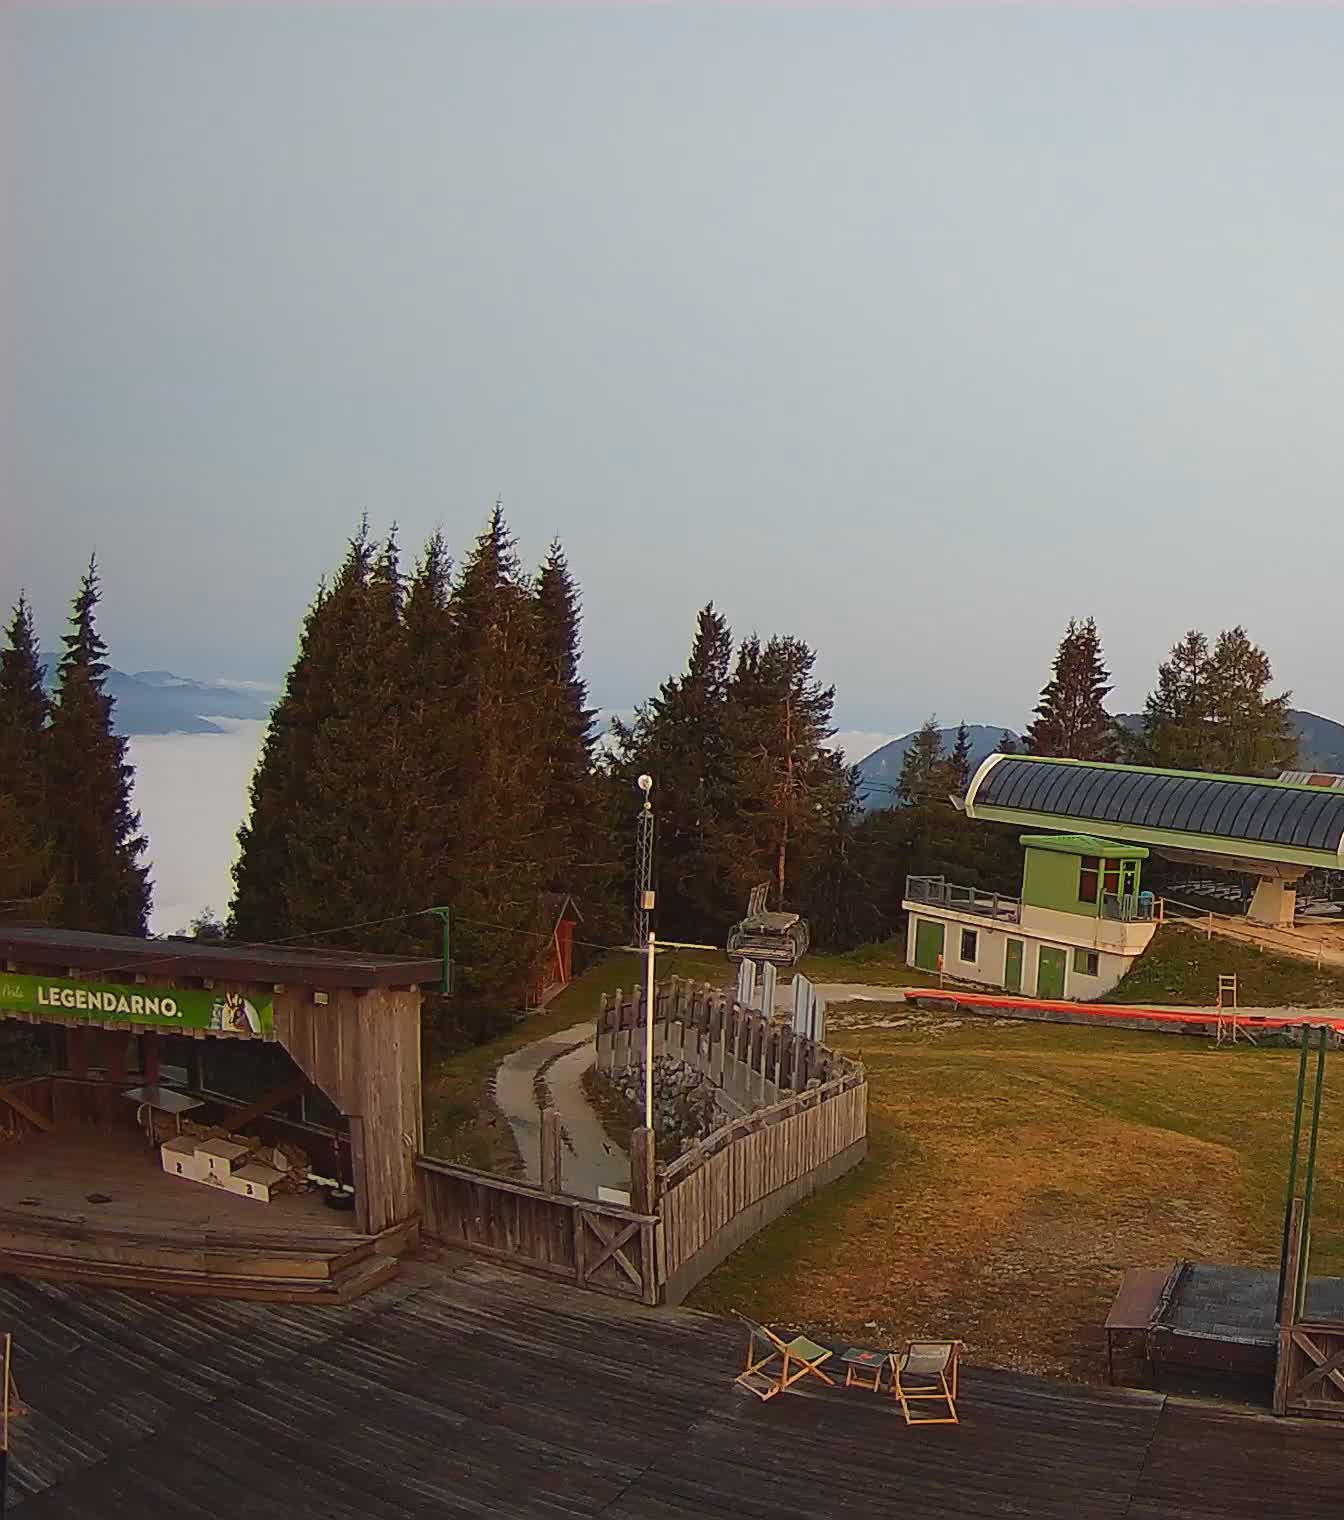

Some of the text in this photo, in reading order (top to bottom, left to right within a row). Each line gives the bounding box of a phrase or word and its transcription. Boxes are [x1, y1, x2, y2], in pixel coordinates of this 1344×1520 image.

[37, 986, 183, 1017] LEGENDARNO.
[176, 1162, 183, 1174] 2
[208, 1158, 214, 1168] 1
[246, 1184, 253, 1194] 3
